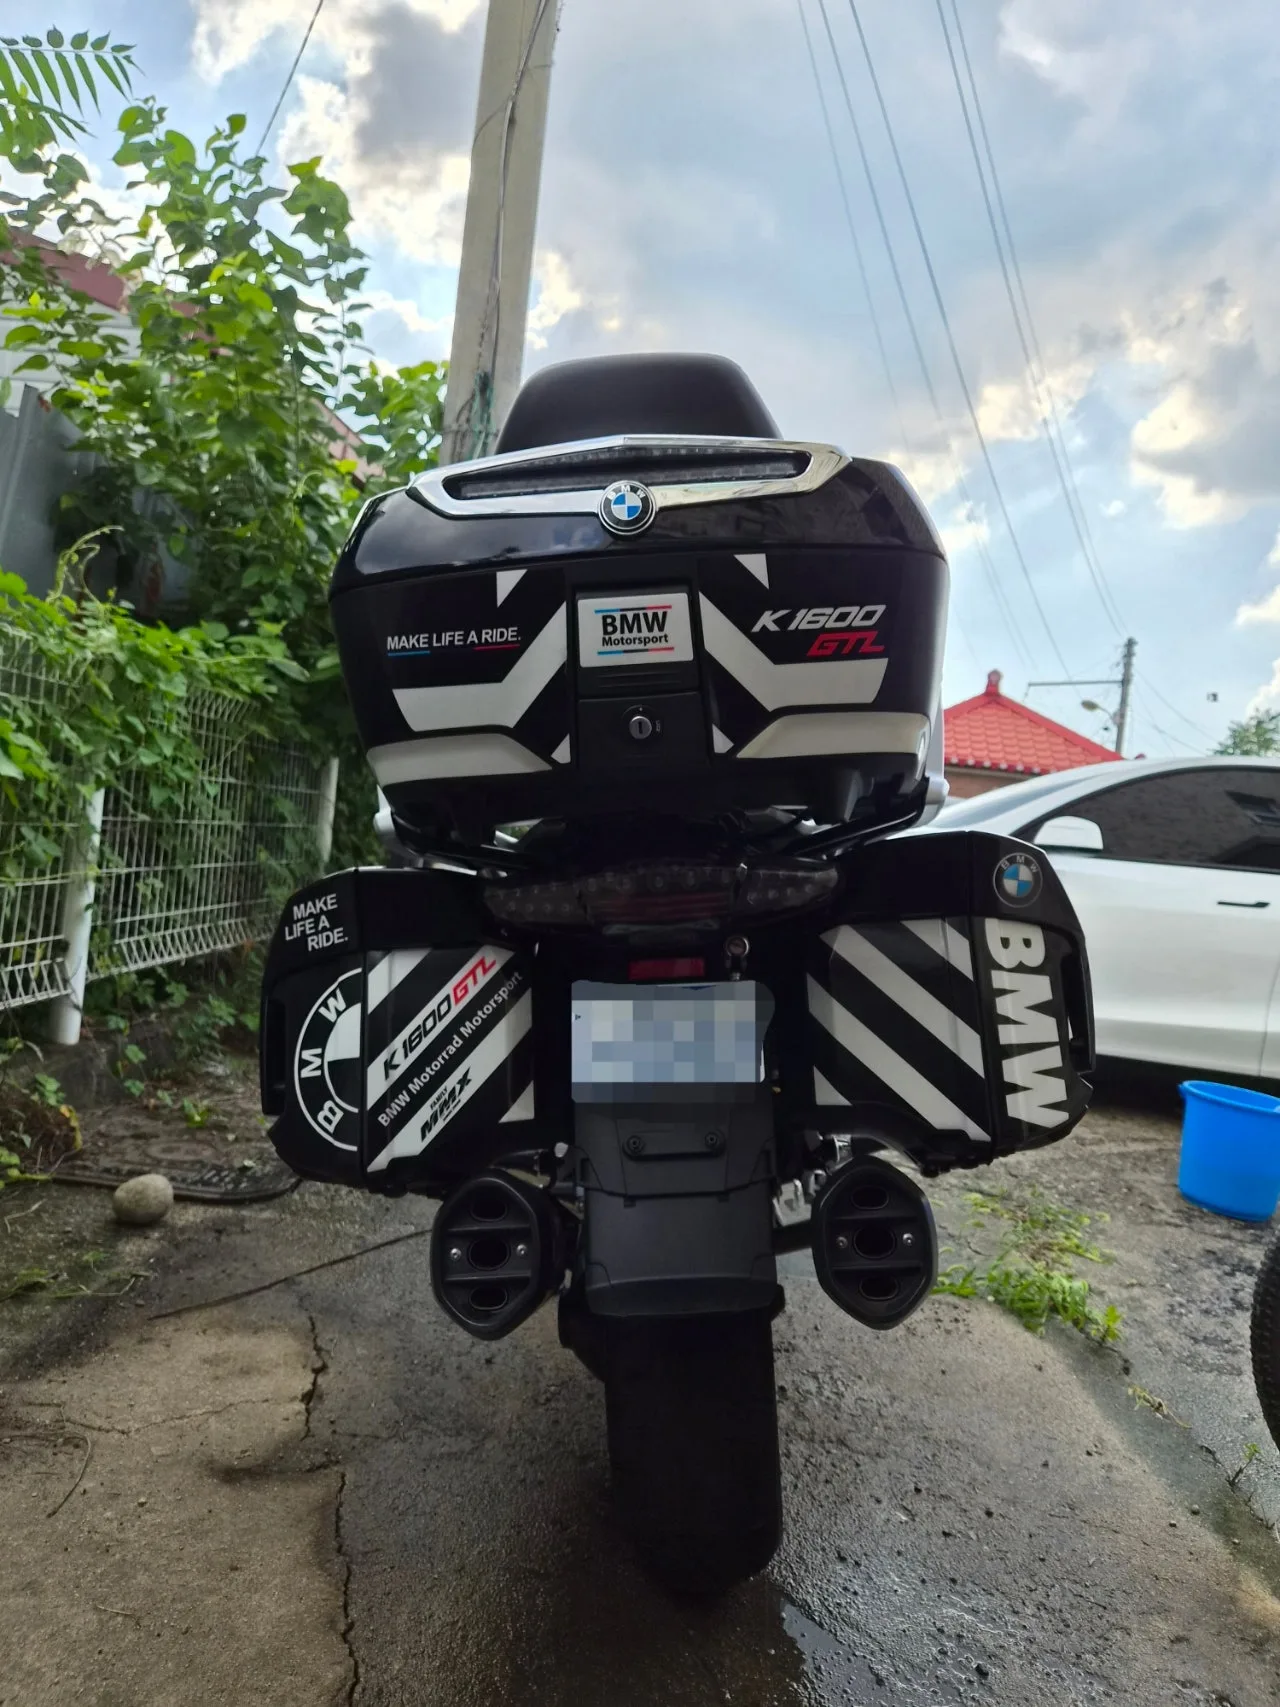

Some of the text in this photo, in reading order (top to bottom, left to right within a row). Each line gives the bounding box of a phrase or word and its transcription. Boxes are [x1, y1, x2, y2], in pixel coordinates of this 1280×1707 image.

[601, 611, 667, 636] BMW
[386, 627, 521, 650] MAKE LIFE A RIDE.
[602, 633, 669, 647] Motorsport
[806, 630, 885, 657] GTL
[293, 893, 338, 921] MAKE
[285, 914, 330, 941] LIFE A
[307, 927, 349, 952] RIDE.
[452, 955, 497, 1007] GTL
[984, 917, 1070, 1129] BMW
[301, 988, 348, 1134] BMW
[377, 971, 523, 1128] BMW Motorrad Motorsport
